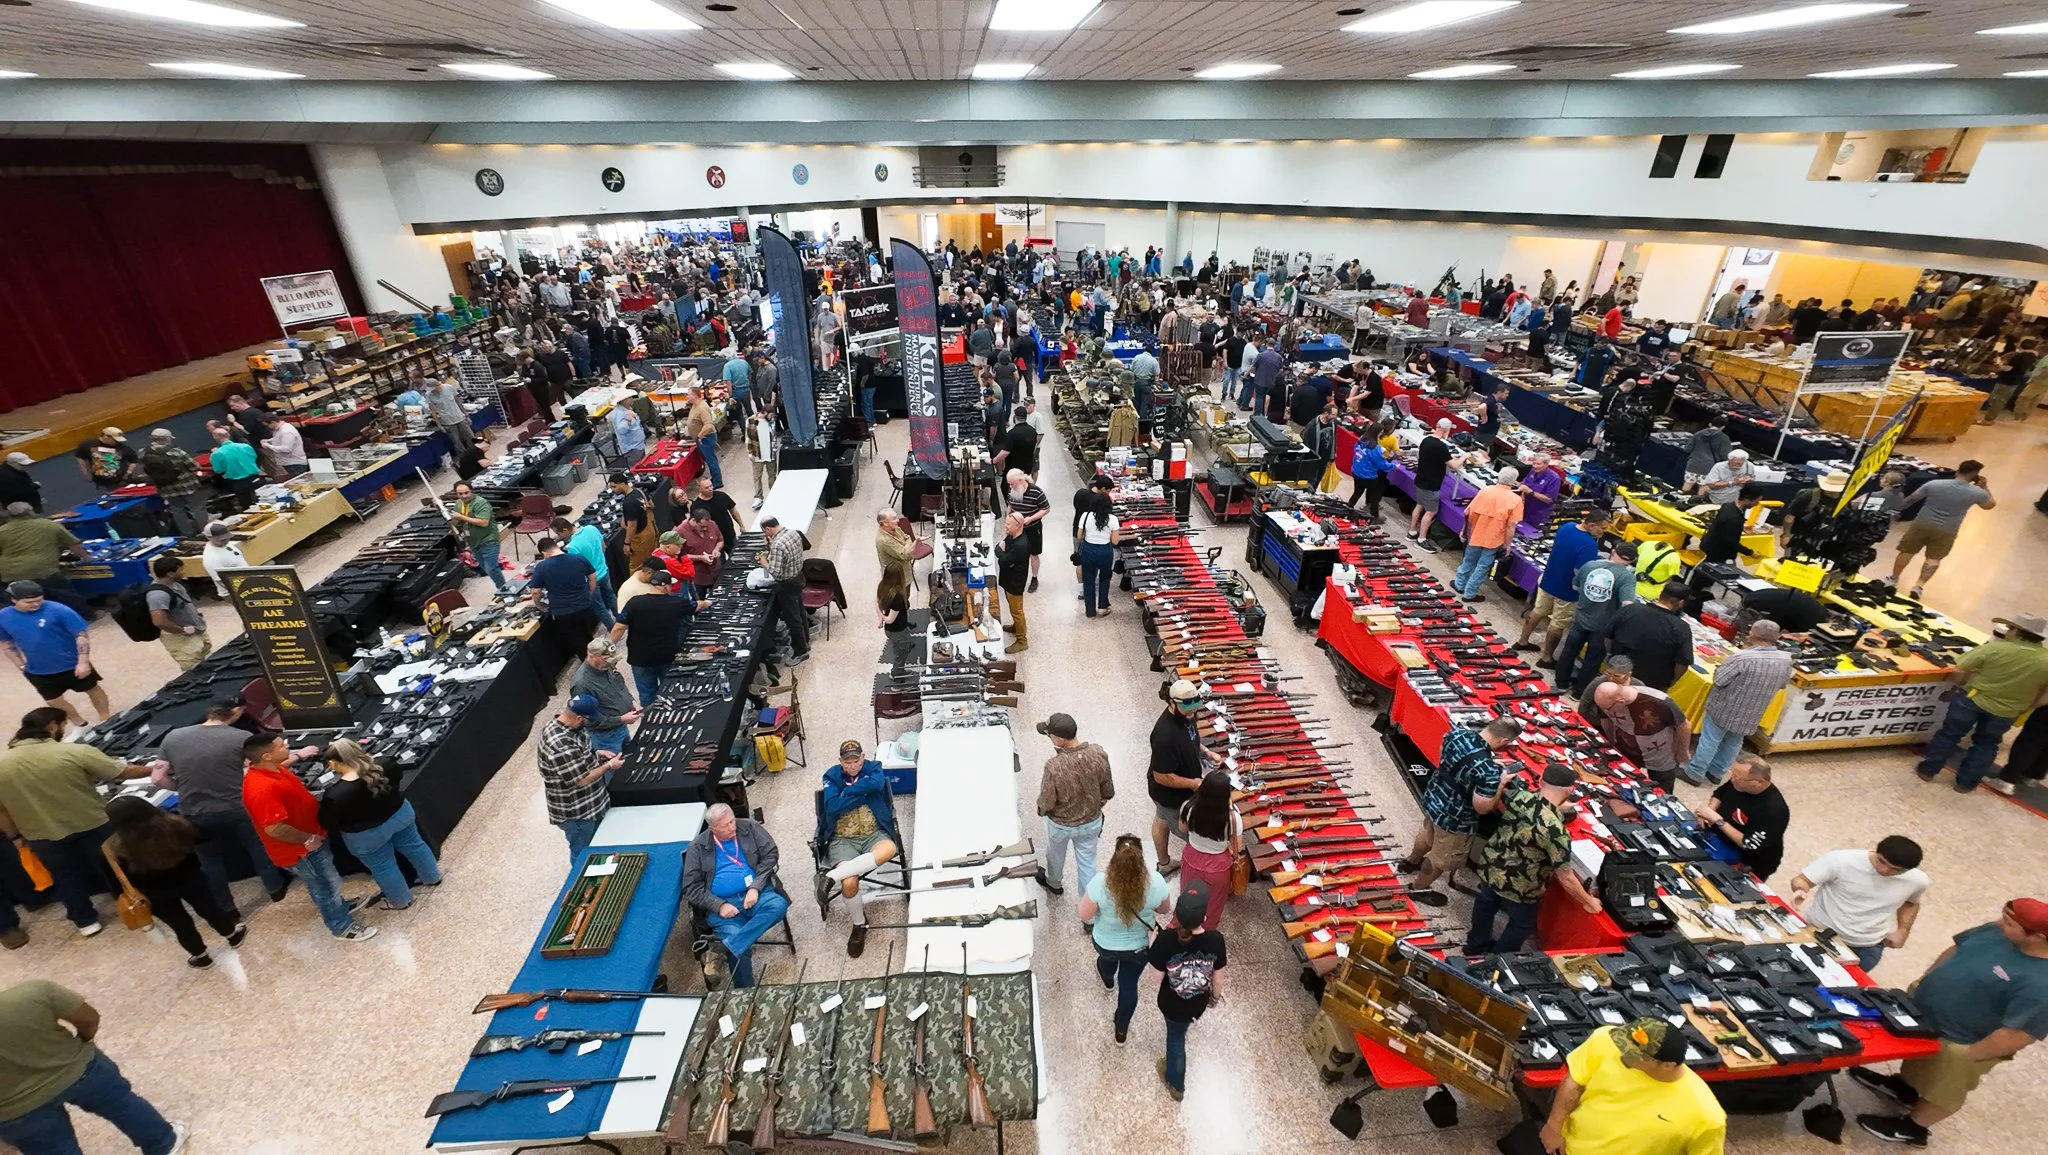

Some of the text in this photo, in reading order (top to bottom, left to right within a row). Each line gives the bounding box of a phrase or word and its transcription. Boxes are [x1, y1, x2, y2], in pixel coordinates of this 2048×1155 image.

[276, 288, 334, 303] RELOADING
[286, 300, 334, 314] SUPPLIES
[849, 302, 890, 318] TAKTEK
[904, 333, 918, 416] INDEPENDENCE
[911, 333, 922, 417] MANUFACTURING
[918, 334, 938, 418] KULAS
[263, 609, 285, 617] AAE
[250, 620, 307, 629] FIREARMS
[1835, 685, 1937, 701] FREEDOM
[1832, 698, 1896, 708] PROTECTIVE
[1809, 705, 1937, 723] HOLSTERS
[1791, 721, 1935, 740] MADE HERE
